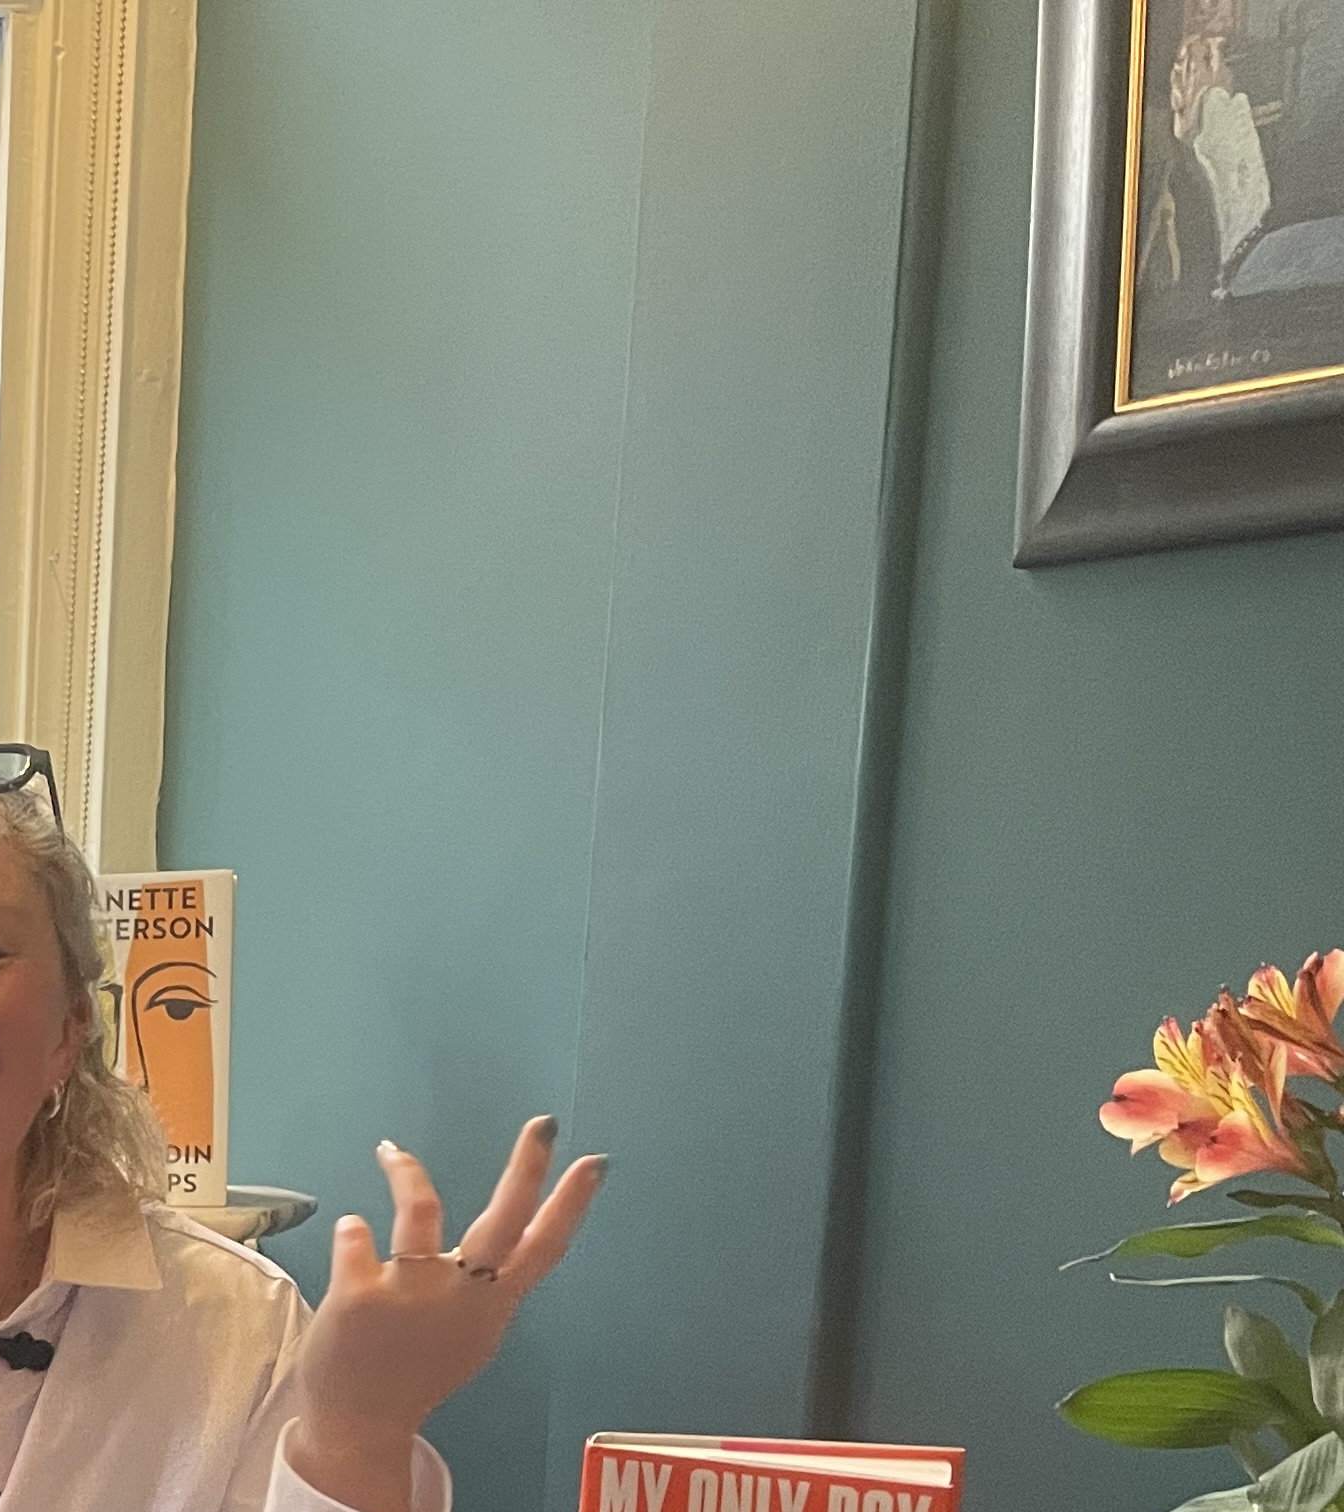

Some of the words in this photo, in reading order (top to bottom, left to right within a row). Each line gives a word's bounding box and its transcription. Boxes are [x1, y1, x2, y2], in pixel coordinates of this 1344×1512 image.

[105, 886, 198, 912] NETTE
[115, 915, 215, 941] ERSON
[164, 1143, 212, 1165] DIN
[166, 1173, 198, 1194] PS
